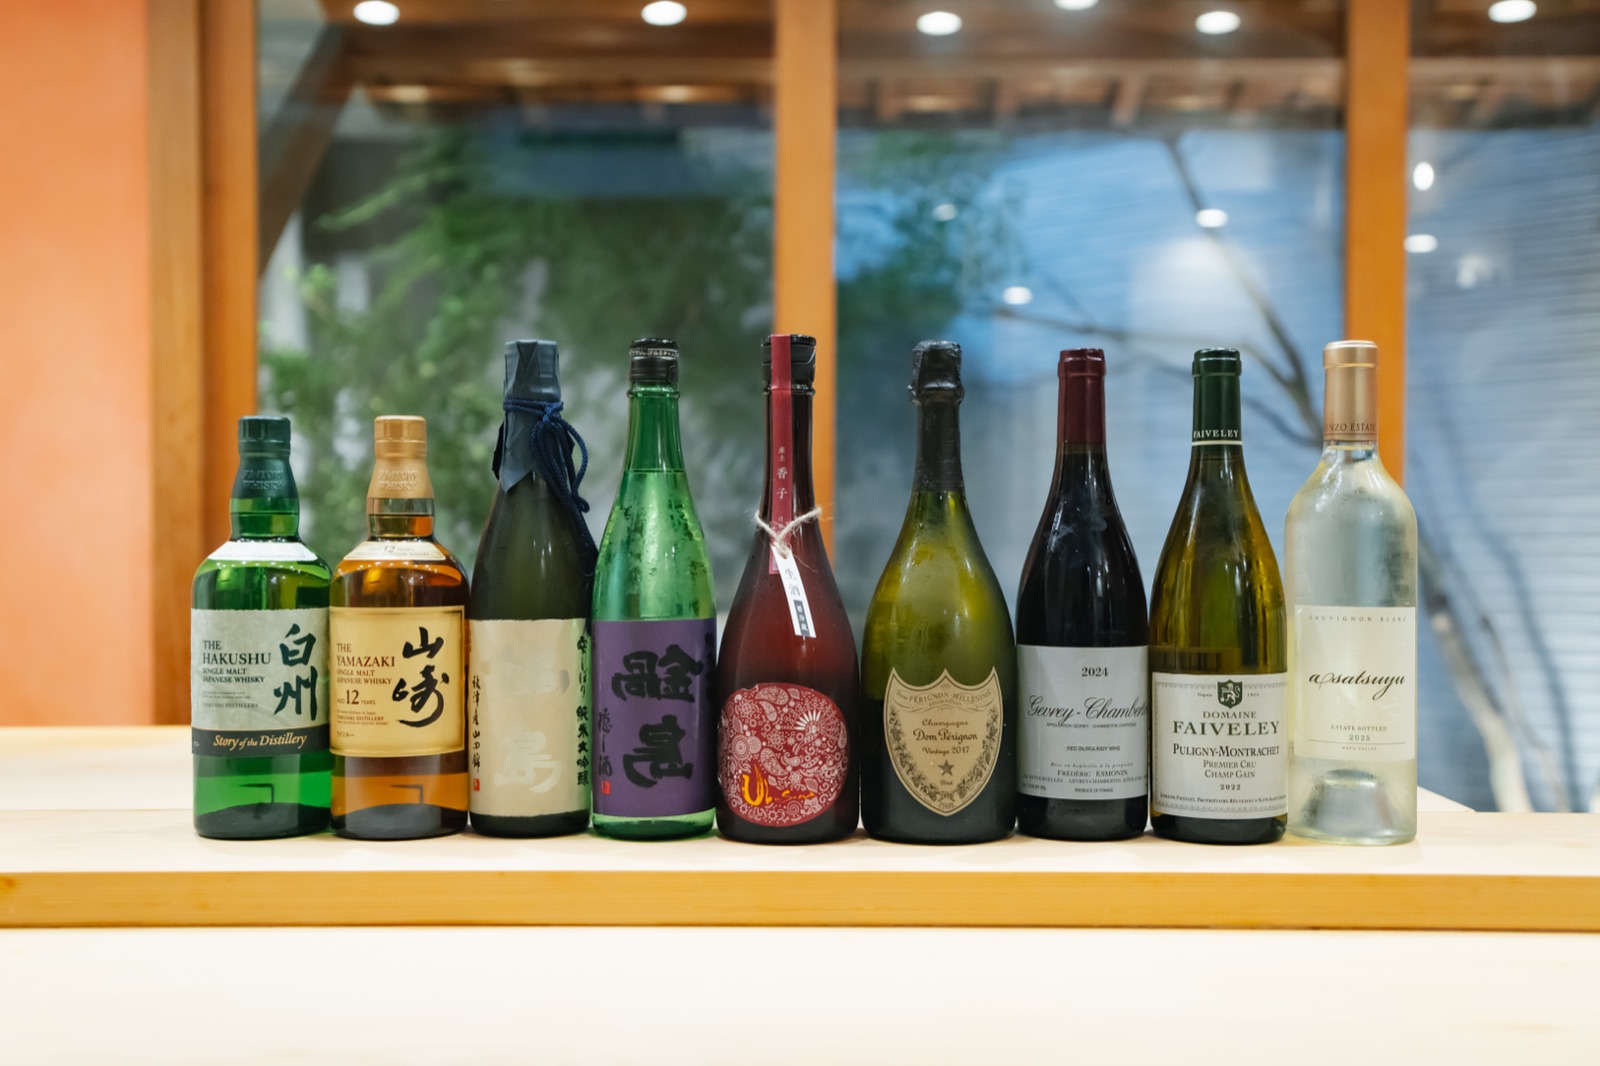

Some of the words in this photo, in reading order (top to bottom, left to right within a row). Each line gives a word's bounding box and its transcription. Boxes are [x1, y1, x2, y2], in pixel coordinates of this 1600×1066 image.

[1193, 429, 1239, 439] FAIVELEY
[776, 467, 788, 500] 香子
[784, 567, 801, 597] 生酒
[203, 640, 221, 650] THE
[336, 643, 352, 653] THE
[203, 652, 272, 665] HAKUSHU
[336, 656, 396, 668] YAMAZAKI
[273, 623, 318, 721] 白州
[391, 626, 451, 729] 山崎
[1081, 666, 1109, 677] 2024
[346, 689, 360, 705] 12
[1202, 710, 1257, 719] DOMAINE
[921, 718, 969, 729] Champagne
[1172, 720, 1280, 736] FAIVELEY
[213, 735, 239, 751] Story
[239, 740, 248, 750] of
[247, 739, 258, 747] the
[260, 732, 308, 750] Distillery
[912, 728, 938, 741] Dom
[938, 728, 978, 744] Pérignon
[921, 746, 950, 756] Vintage
[951, 746, 970, 755] 2017
[1172, 743, 1280, 757] PULIGNY-MONTRACHET
[1203, 759, 1239, 768] PREMIER
[1240, 759, 1256, 768] CRU
[1057, 769, 1092, 777] FRÉDÉRIC
[1095, 769, 1128, 777] ESMONIN
[1204, 769, 1234, 778] CHAMP
[1235, 769, 1256, 778] GAIN
